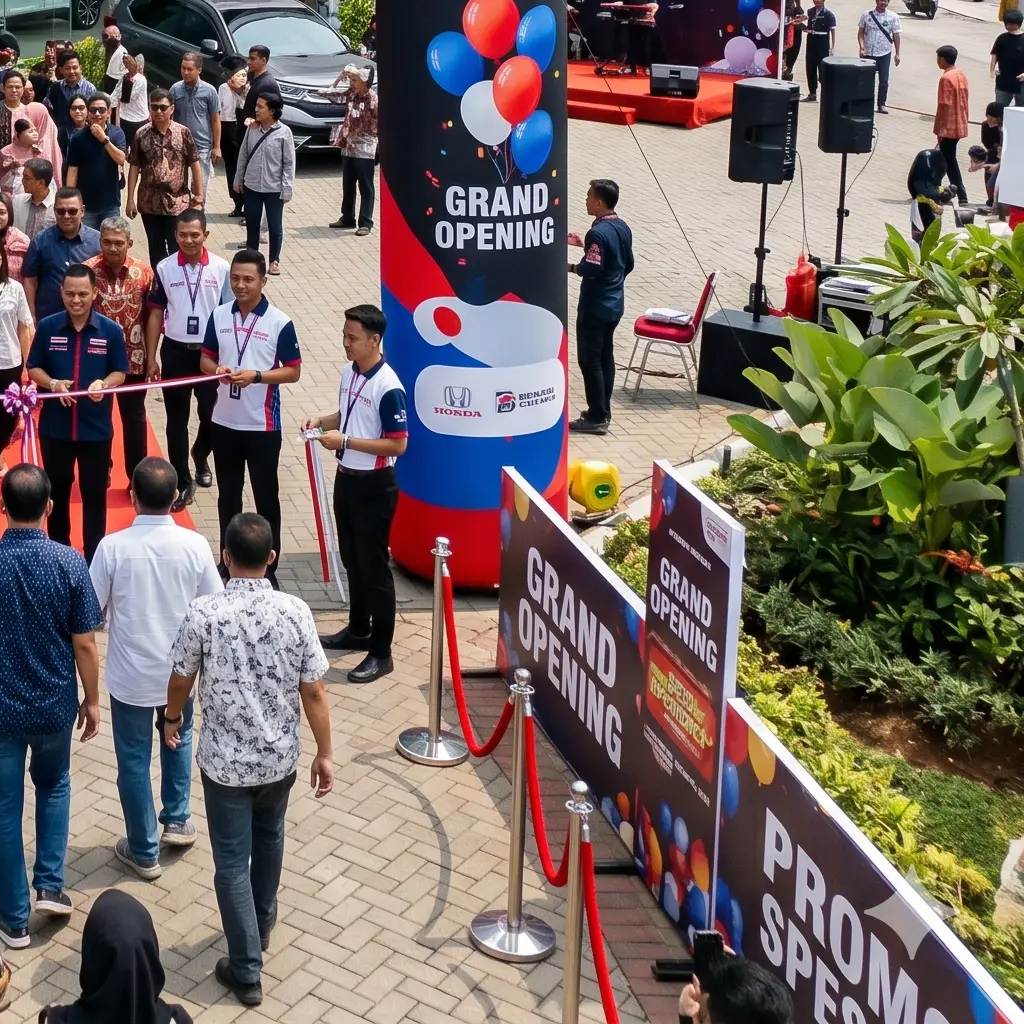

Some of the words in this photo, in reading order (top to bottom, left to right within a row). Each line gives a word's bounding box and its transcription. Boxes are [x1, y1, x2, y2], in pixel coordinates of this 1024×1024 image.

[435, 216, 555, 251] OPENING
[445, 182, 550, 218] GRAND
[434, 407, 483, 418] HONDA
[527, 546, 617, 688] GRAND
[650, 583, 717, 673] OPENING
[660, 556, 713, 628] GRAND
[518, 597, 622, 770] OPENING
